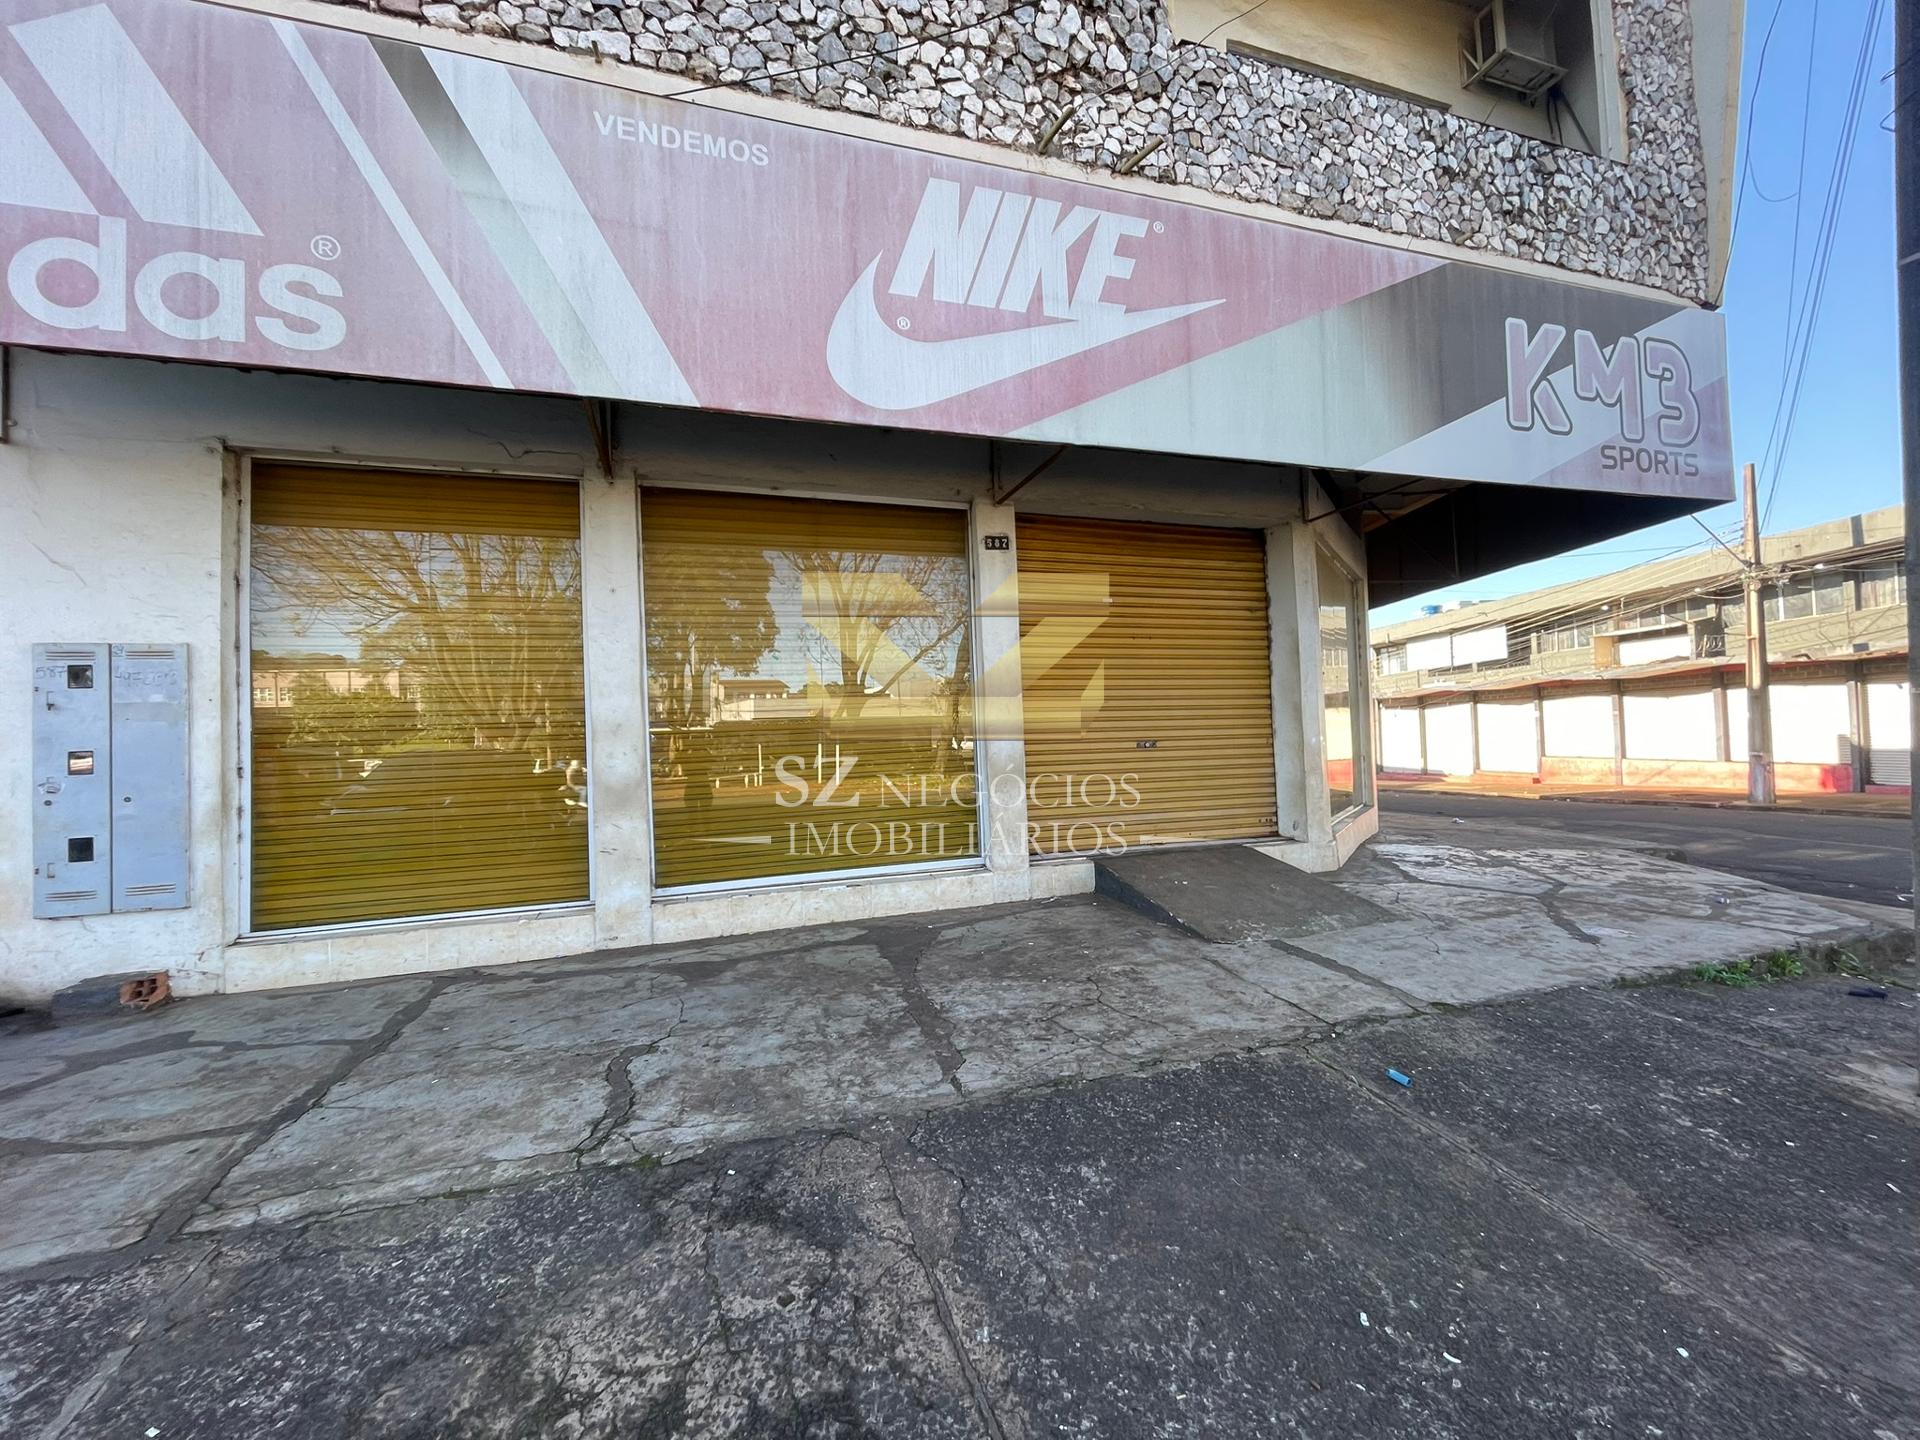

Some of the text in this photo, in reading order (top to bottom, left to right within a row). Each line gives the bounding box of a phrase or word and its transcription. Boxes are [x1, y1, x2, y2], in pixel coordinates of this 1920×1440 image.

[593, 111, 769, 166] VENDEMOS
[888, 177, 1150, 320] NIKE
[1504, 316, 1700, 448] KM3
[1600, 444, 1699, 477] SPORTS
